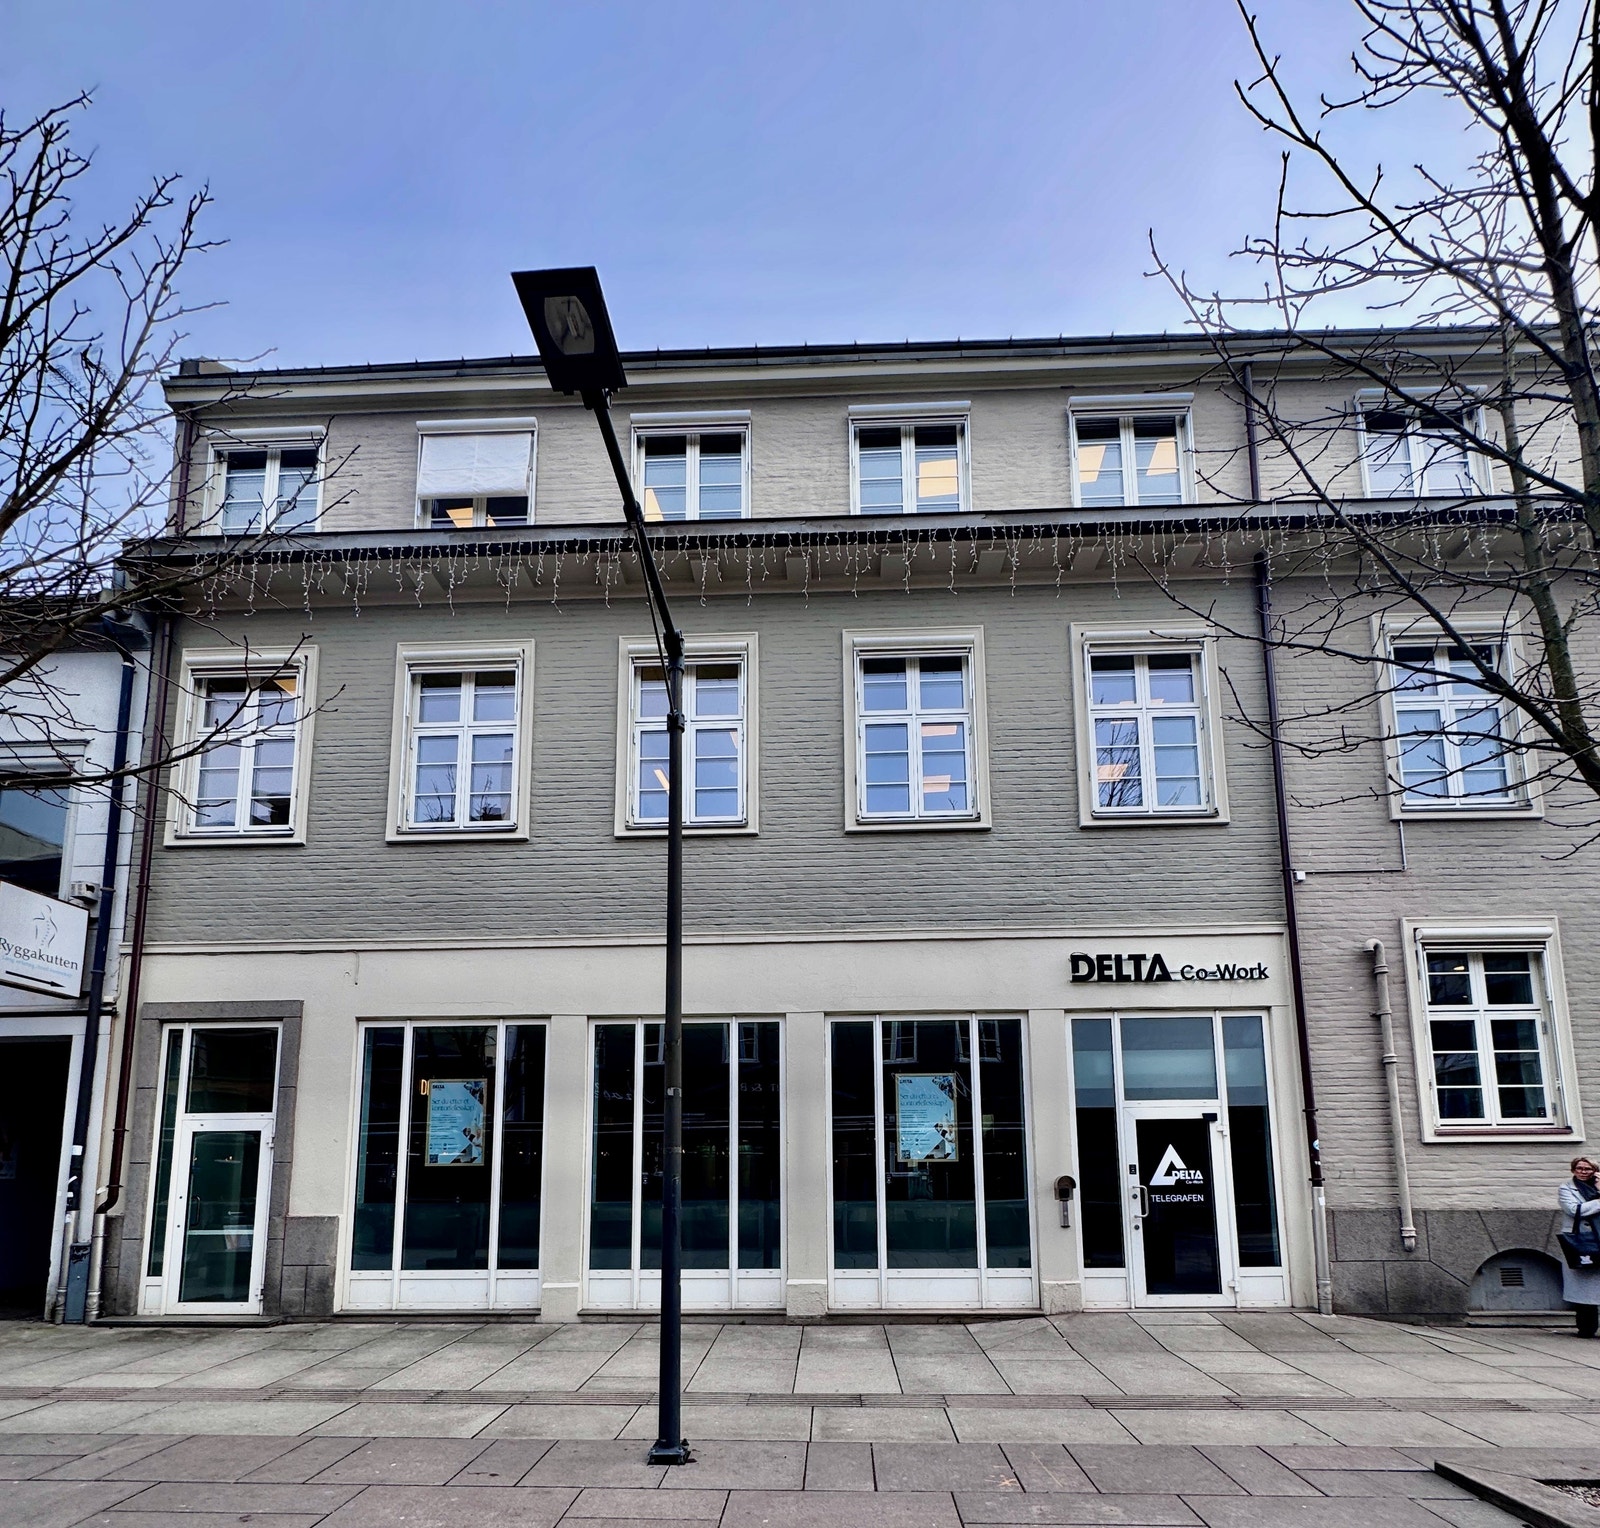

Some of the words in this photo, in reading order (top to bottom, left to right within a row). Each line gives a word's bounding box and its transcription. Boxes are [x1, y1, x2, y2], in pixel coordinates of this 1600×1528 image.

[0, 937, 78, 970] Ryggakutten
[1070, 953, 1172, 982] DELTA
[1180, 963, 1269, 980] Co-Work
[1172, 1170, 1204, 1180] DELTA
[1150, 1194, 1204, 1202] TELEGRAFEN
